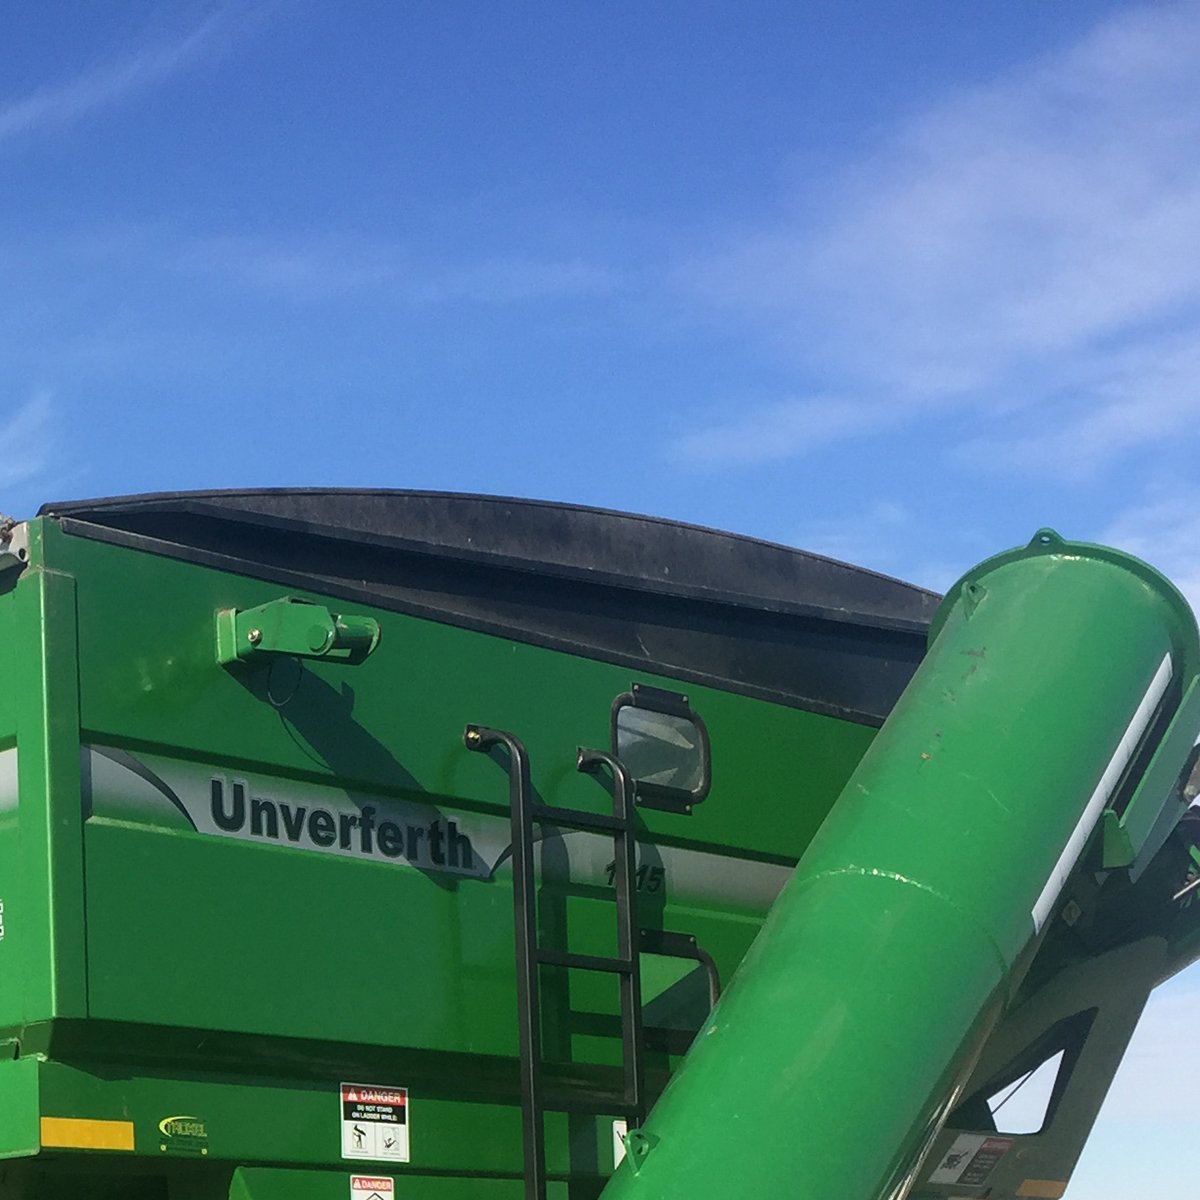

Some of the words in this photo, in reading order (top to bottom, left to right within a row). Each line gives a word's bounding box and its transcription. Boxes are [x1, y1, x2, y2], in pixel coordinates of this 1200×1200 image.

[210, 777, 475, 870] Unverferth
[605, 860, 666, 892] 115
[360, 1090, 400, 1103] DANGER
[361, 1179, 391, 1190] DANGER
